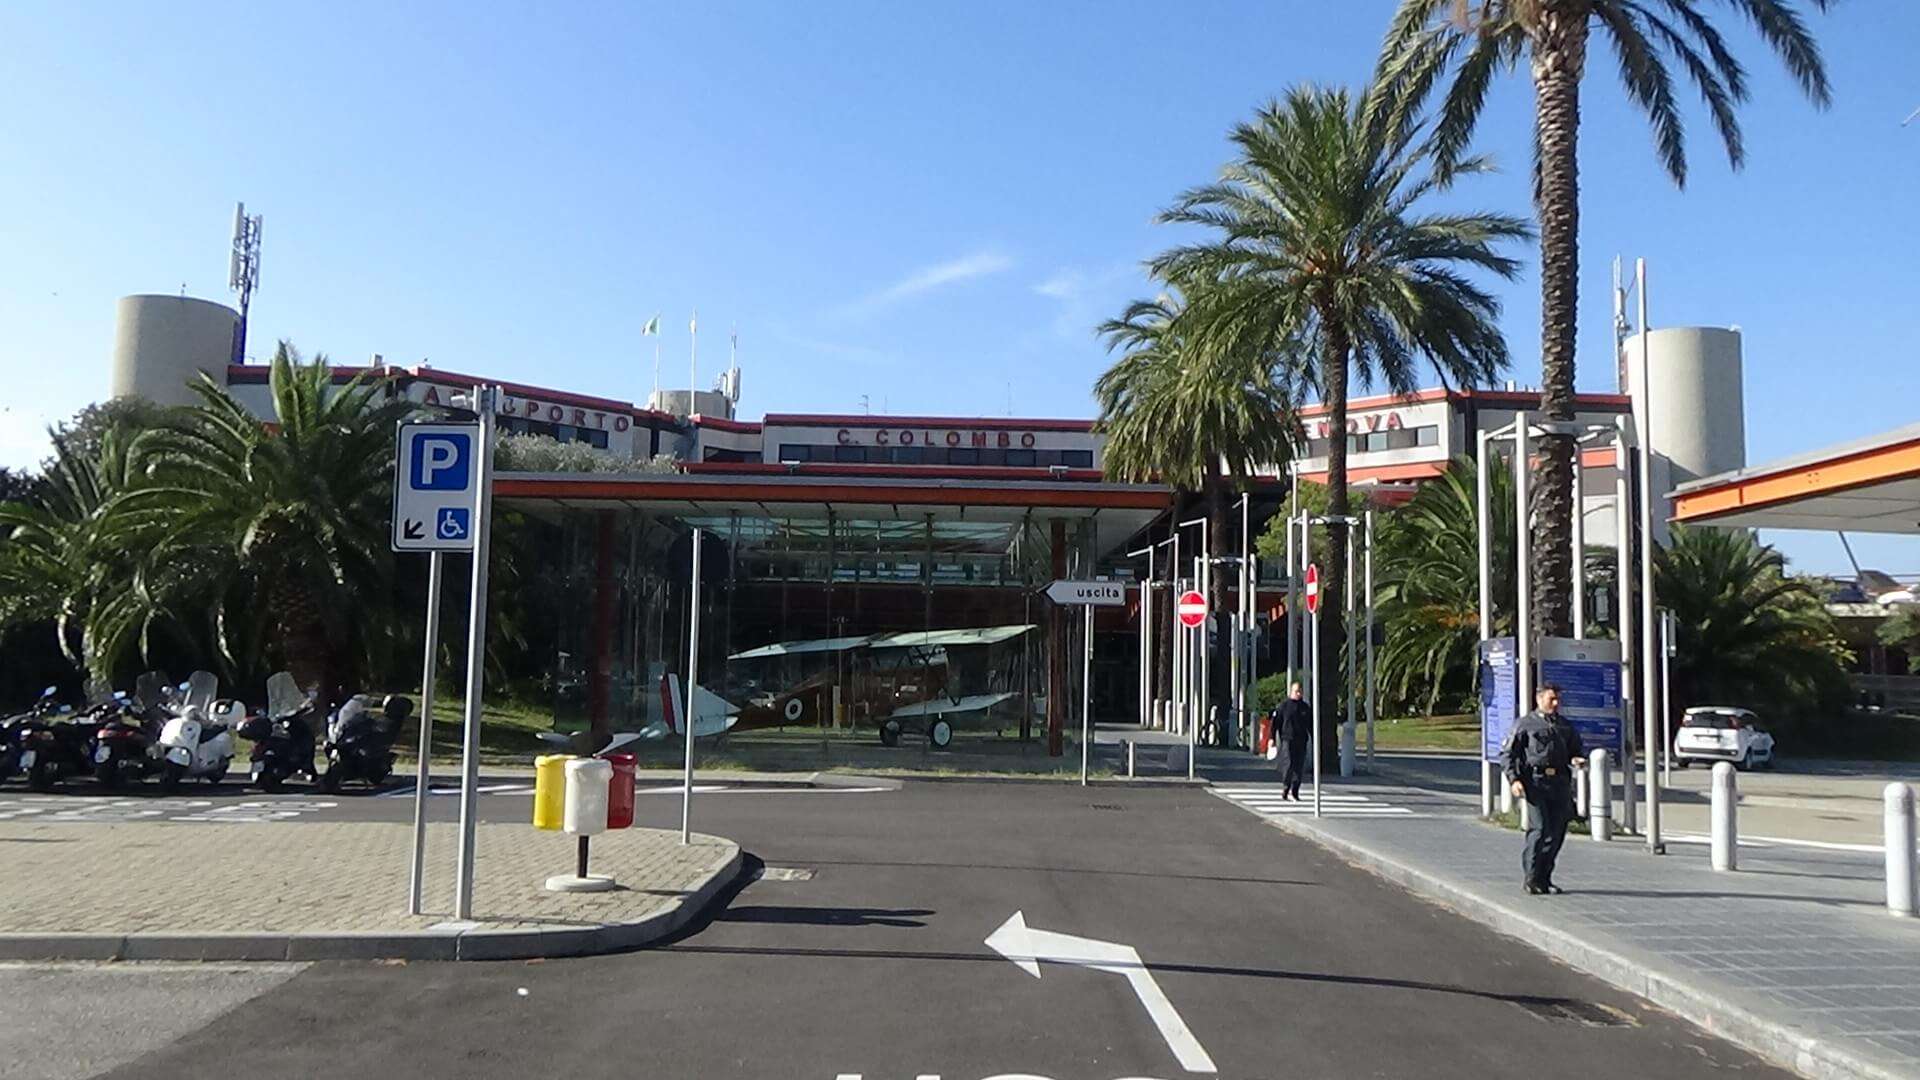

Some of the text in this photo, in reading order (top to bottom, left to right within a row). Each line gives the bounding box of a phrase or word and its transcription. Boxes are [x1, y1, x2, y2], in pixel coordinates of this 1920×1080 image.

[424, 386, 629, 432] AOPORTO
[837, 429, 1036, 448] C. COLOMBO
[422, 440, 458, 484] P
[1077, 587, 1120, 598] uscita
